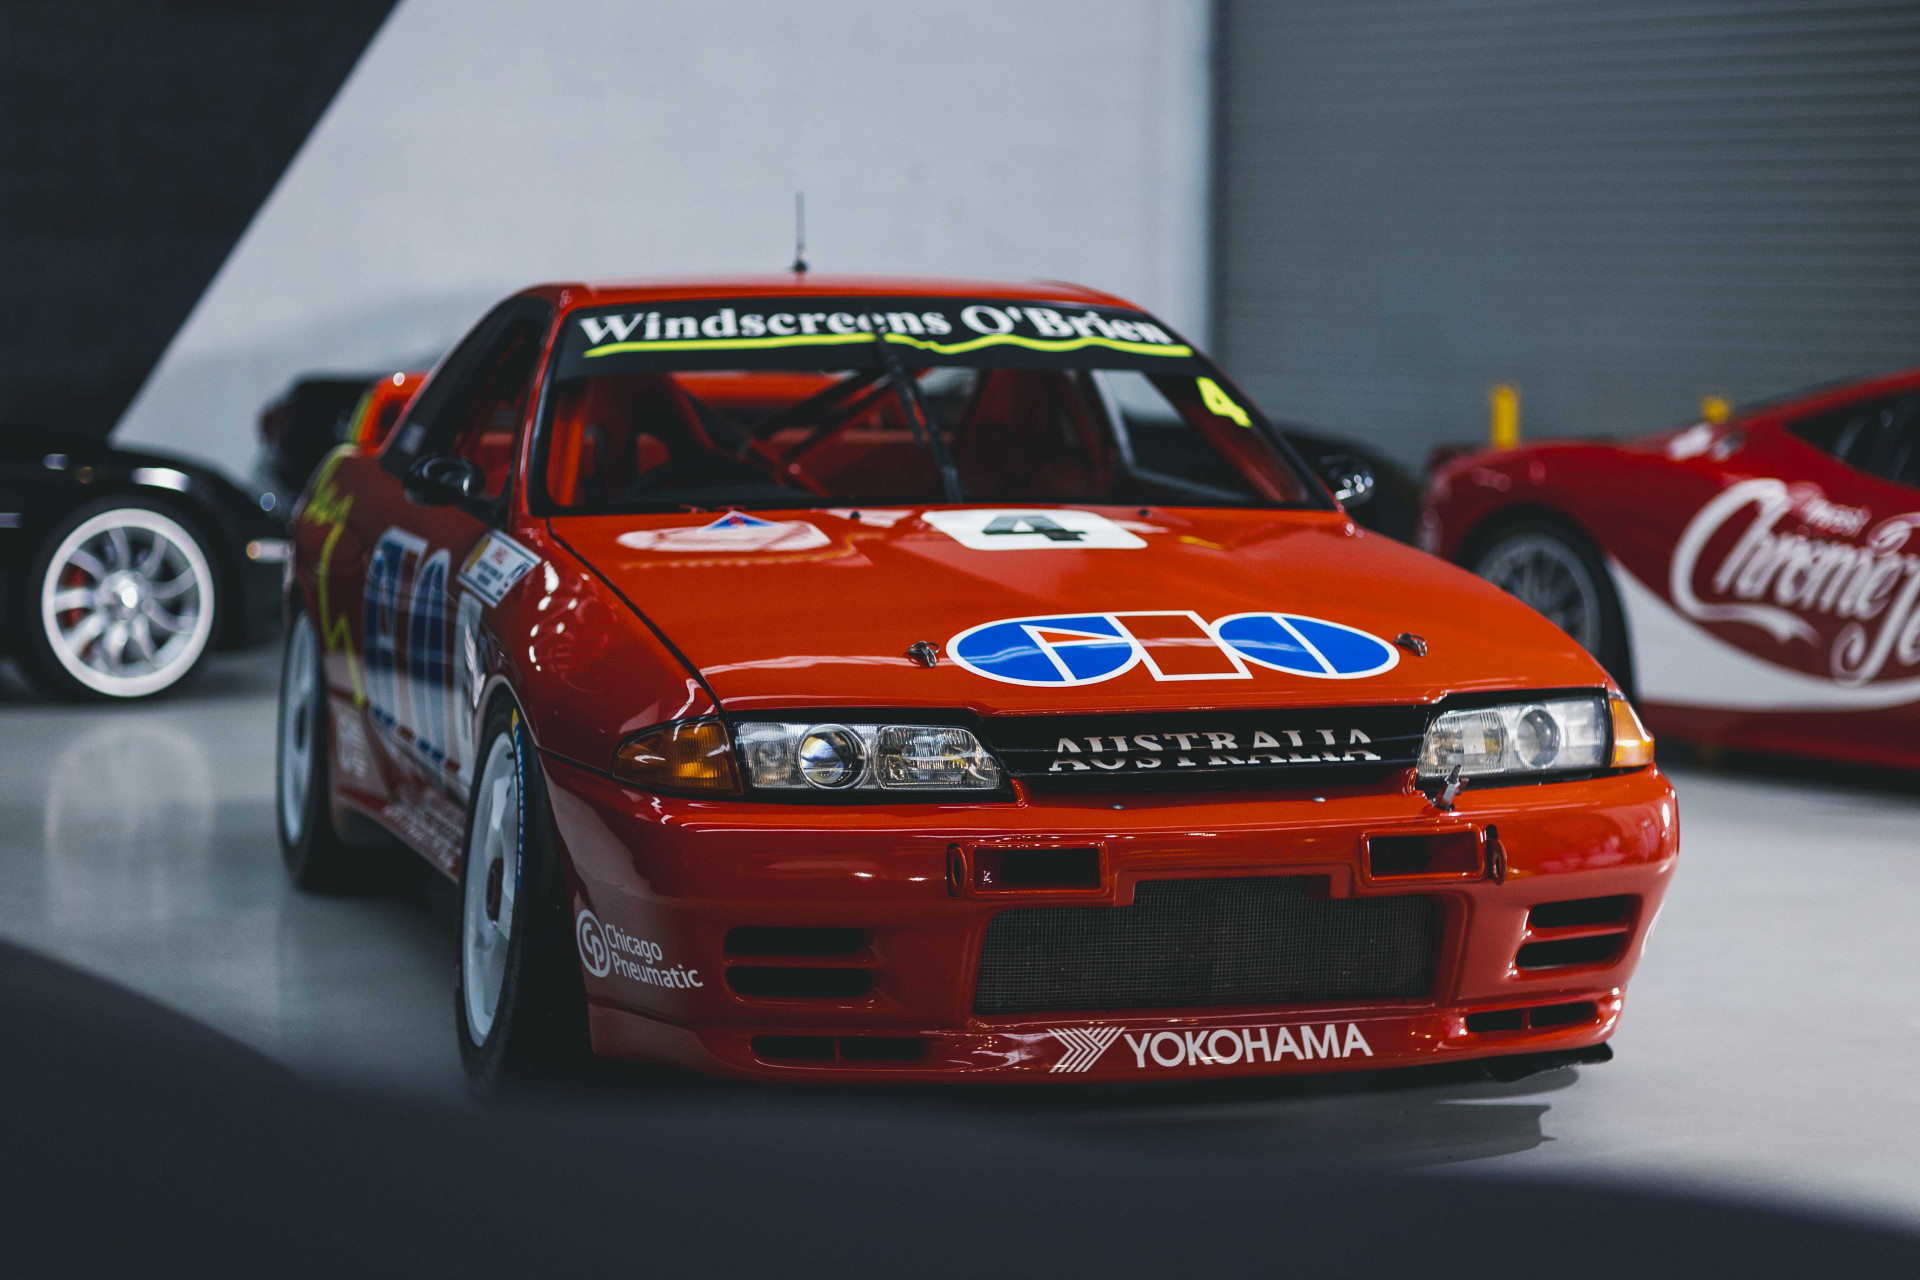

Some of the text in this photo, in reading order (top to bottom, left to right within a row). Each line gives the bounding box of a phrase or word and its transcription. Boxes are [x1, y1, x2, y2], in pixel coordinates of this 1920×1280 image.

[579, 306, 1174, 344] Windscreens O'Brien
[1196, 376, 1251, 428] 4
[982, 515, 1087, 542] 4
[1049, 729, 1381, 772] AUSTRALIA
[605, 923, 663, 964] Chicago
[611, 951, 703, 988] Pneumatic
[1123, 1023, 1374, 1068] YOKOHAMA
